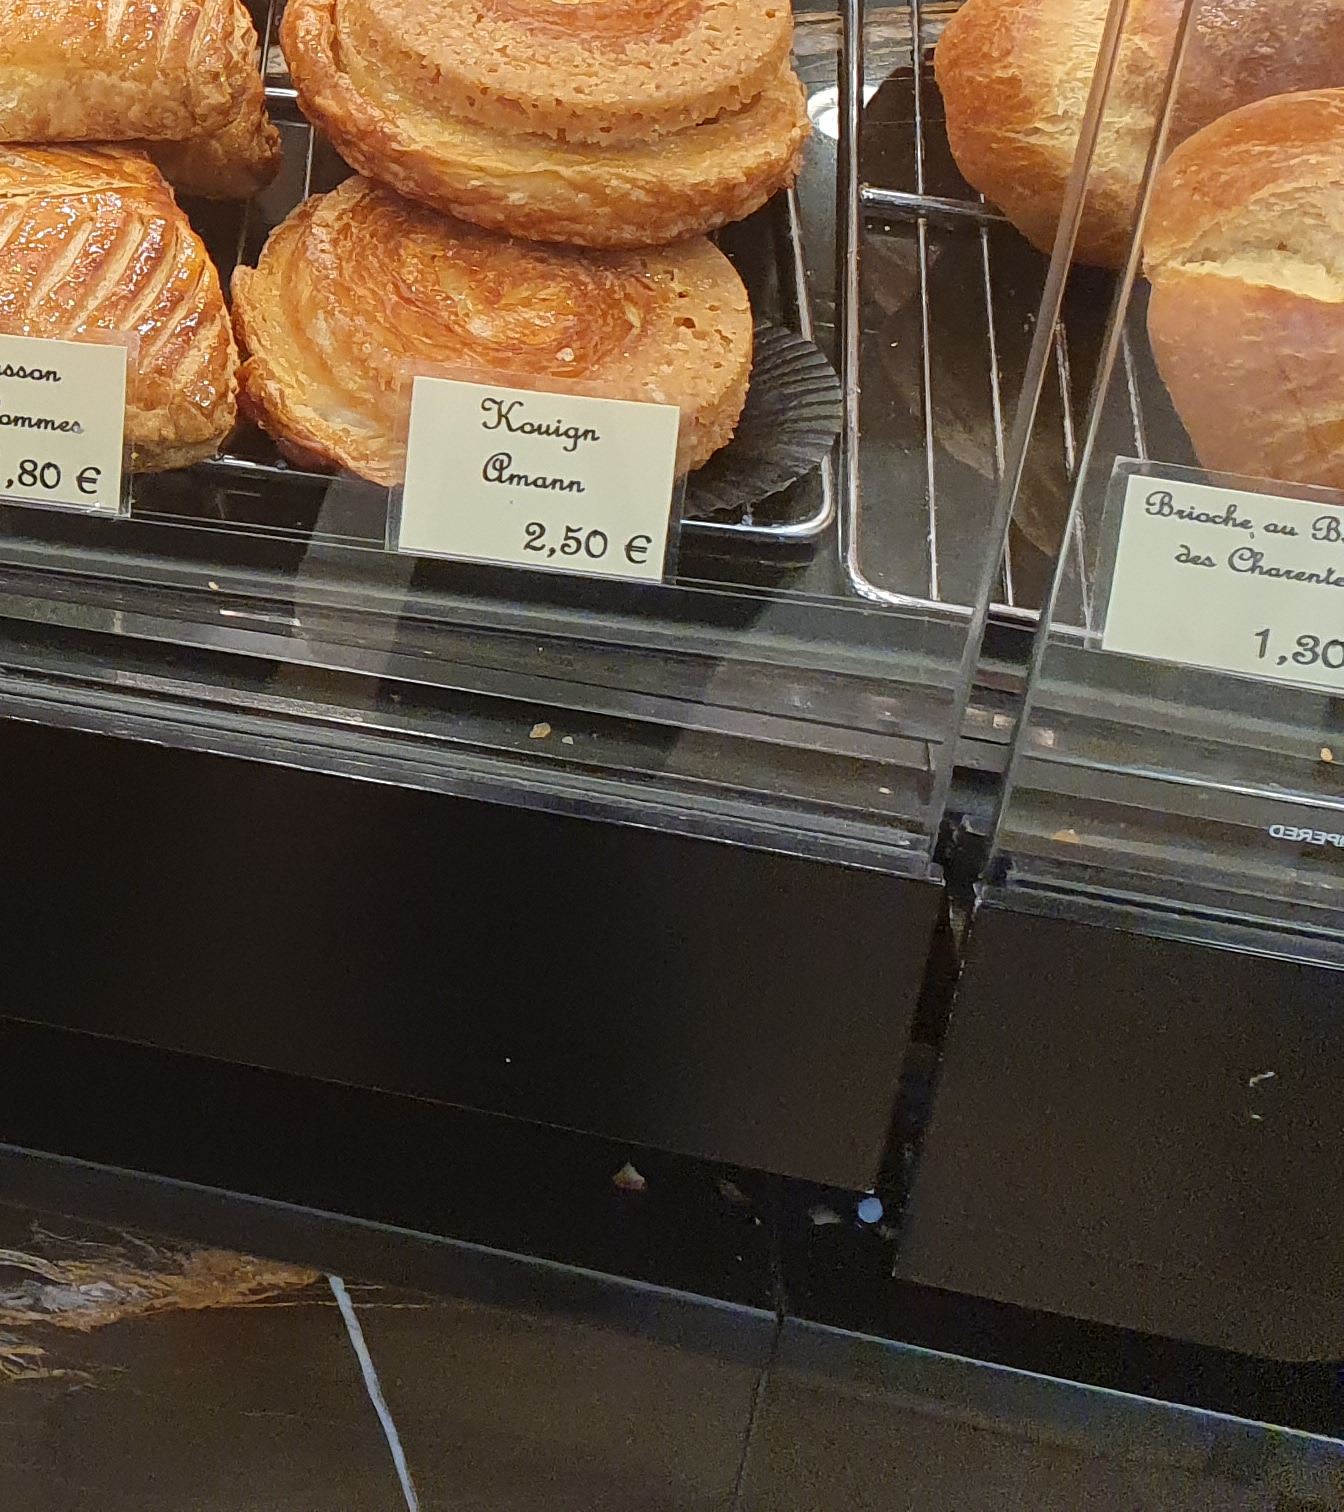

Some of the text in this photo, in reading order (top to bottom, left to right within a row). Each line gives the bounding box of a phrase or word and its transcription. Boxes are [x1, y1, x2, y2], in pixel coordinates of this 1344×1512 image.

[481, 397, 600, 452] Kouign
[76, 467, 102, 494] €
[482, 452, 585, 493] Amann
[1145, 490, 1344, 543] Brioche au B
[523, 522, 652, 564] 2,50 €
[1174, 544, 1217, 568] des
[1254, 628, 1344, 669] 1,30
